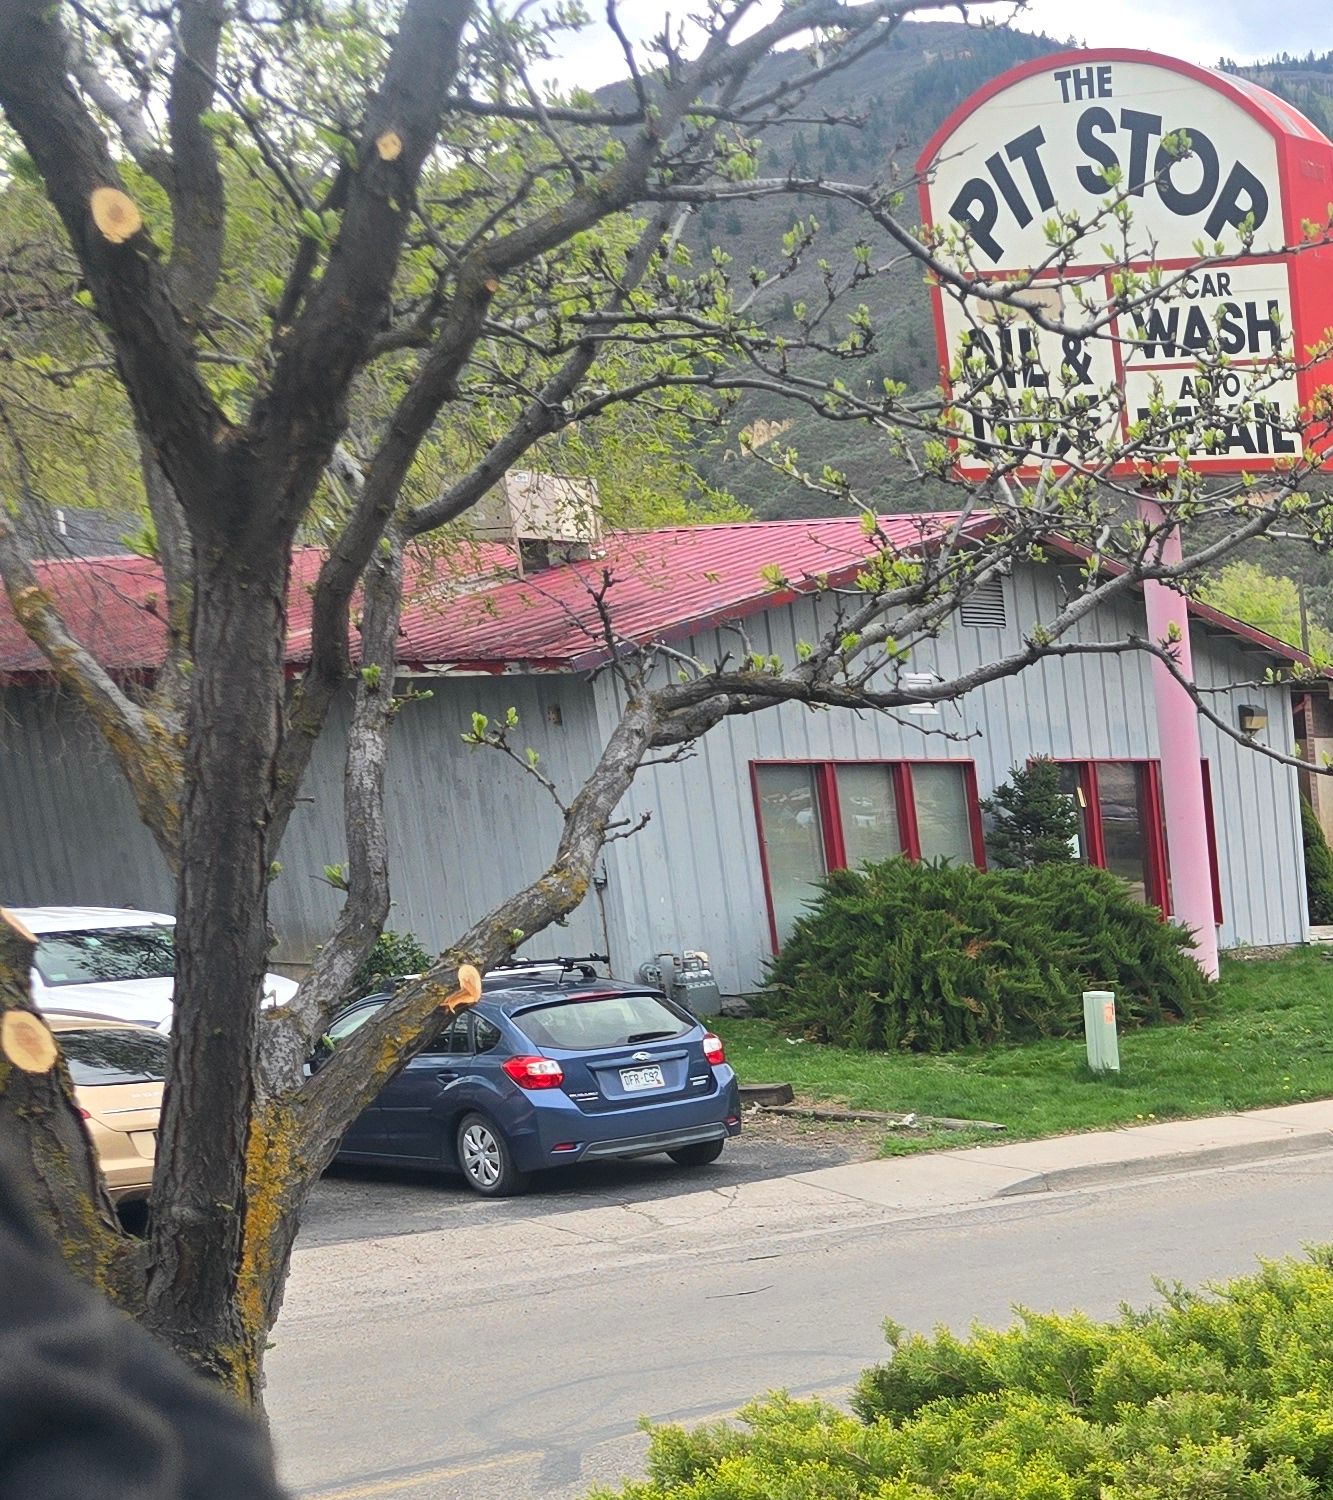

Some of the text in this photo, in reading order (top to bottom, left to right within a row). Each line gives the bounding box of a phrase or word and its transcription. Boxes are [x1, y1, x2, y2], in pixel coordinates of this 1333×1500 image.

[1054, 66, 1113, 103] THE
[948, 107, 1269, 264] PIT STOP
[1183, 272, 1232, 299] CAR
[963, 327, 1095, 389] OIL &
[1131, 300, 1283, 359] WASH
